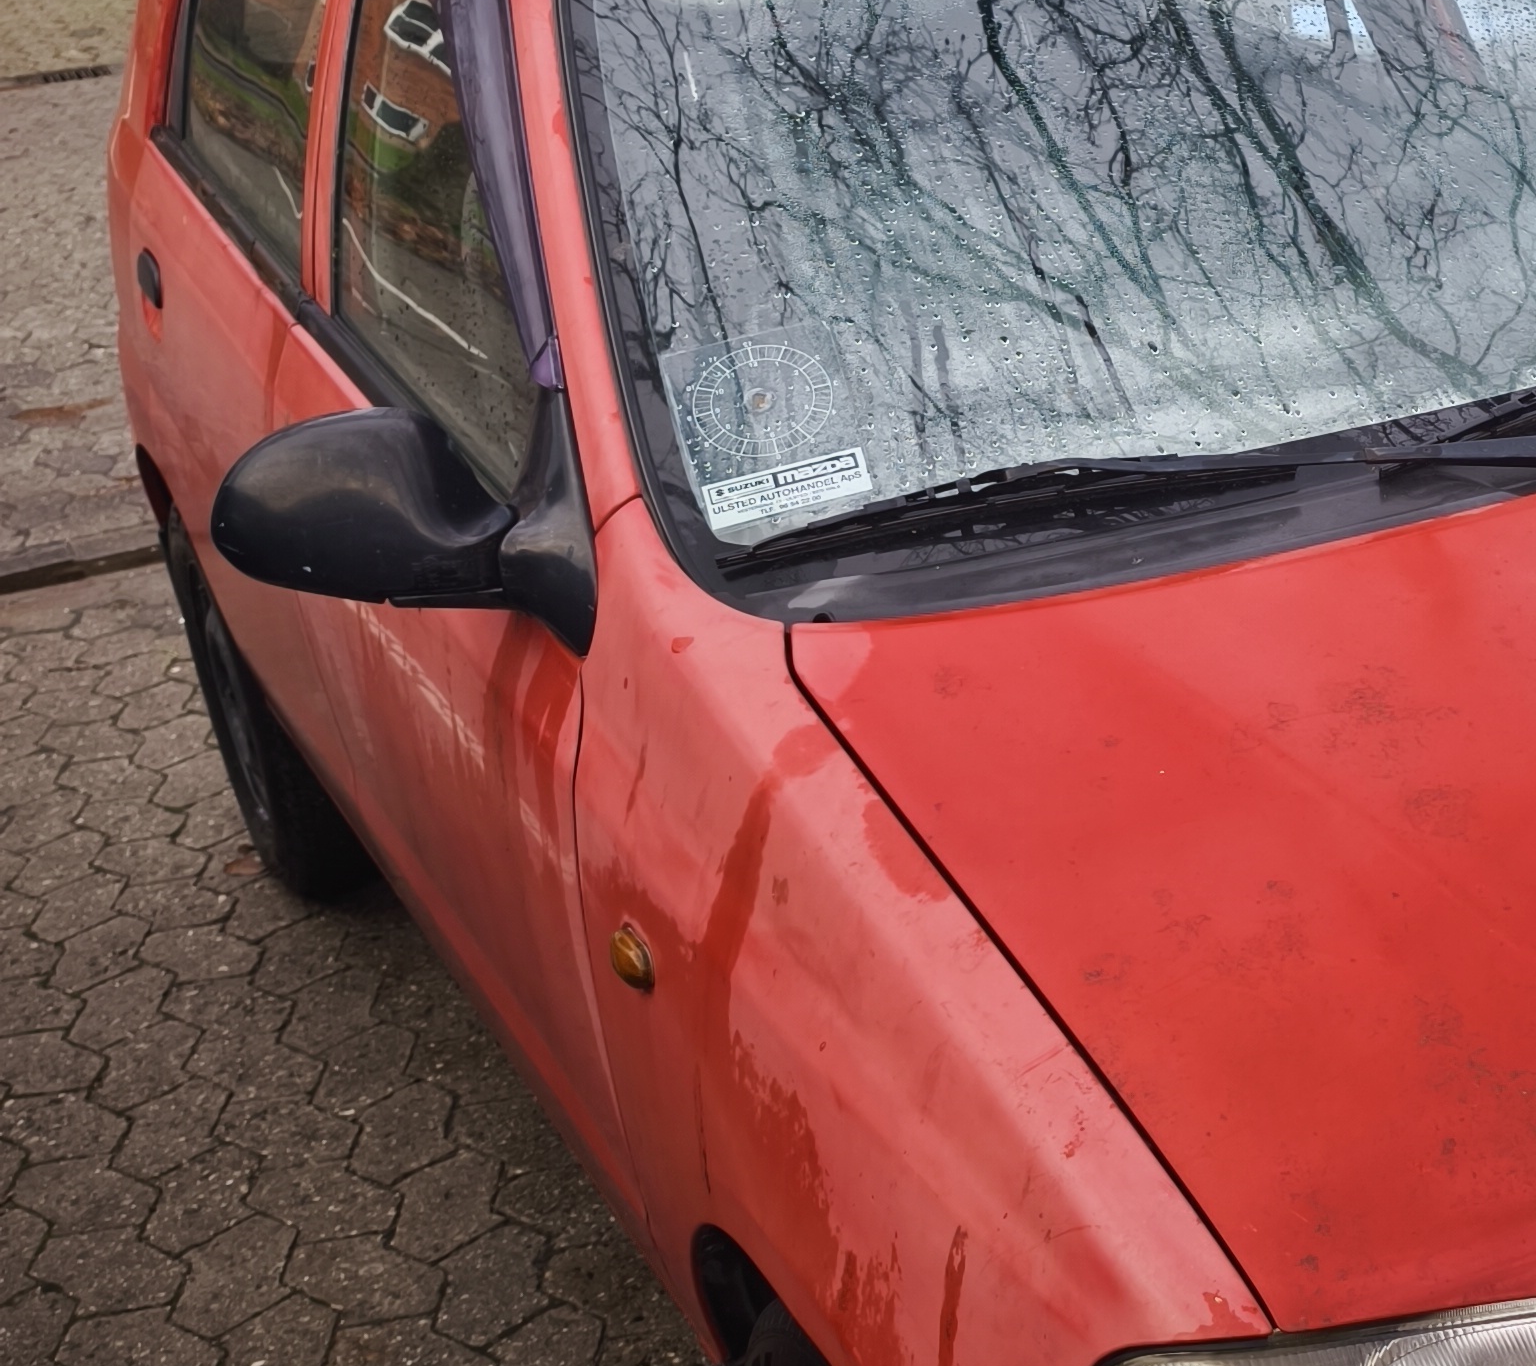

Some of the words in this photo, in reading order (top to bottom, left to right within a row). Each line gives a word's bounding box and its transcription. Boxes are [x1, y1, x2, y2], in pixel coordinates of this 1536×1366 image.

[712, 498, 757, 515] ULSTED
[760, 477, 839, 504] AUTOHANDEL
[841, 471, 862, 483] ApS
[728, 478, 770, 492] SUZUKI
